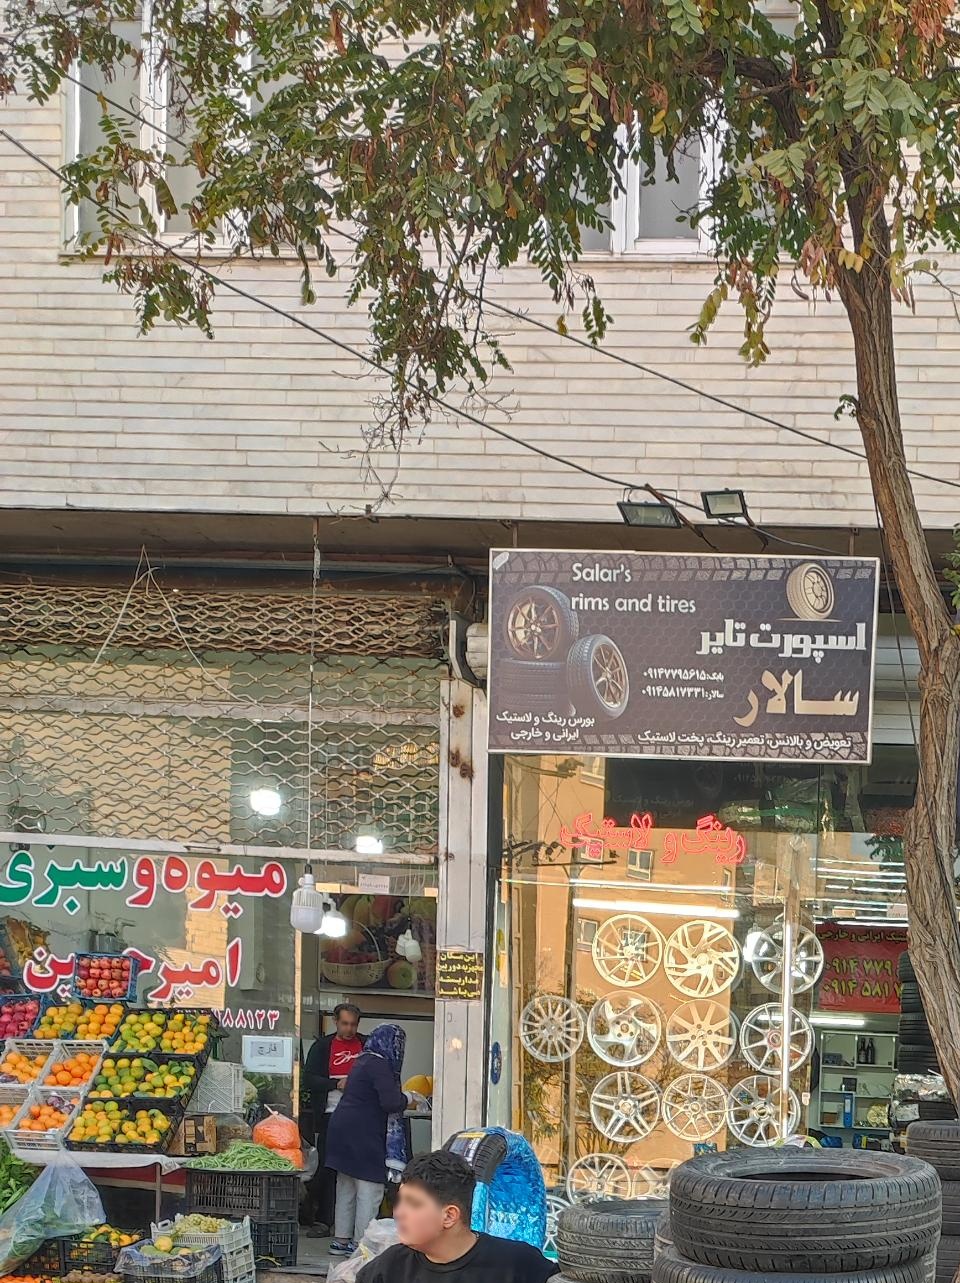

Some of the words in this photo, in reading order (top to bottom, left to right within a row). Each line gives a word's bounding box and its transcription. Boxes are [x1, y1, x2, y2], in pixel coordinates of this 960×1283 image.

[572, 562, 632, 583] Salar's
[571, 593, 610, 611] rims
[615, 593, 653, 612] and
[657, 595, 697, 613] tires
[695, 618, 747, 655] تایر
[750, 622, 867, 664] اسپورت
[732, 668, 860, 728] سالار
[496, 710, 532, 724] لاستیک
[533, 715, 541, 726] و
[542, 711, 567, 727] رینگ
[567, 716, 595, 728] بورس
[510, 726, 543, 741] خارجی
[544, 730, 551, 741] و
[552, 728, 579, 742] ایرانی
[637, 730, 676, 743] لاستیک
[678, 734, 704, 748] پخت
[737, 734, 765, 749] تعمیر
[805, 739, 812, 749] و
[813, 736, 852, 750] تعویض
[560, 812, 652, 858] لاستیک
[681, 814, 747, 864] رینگ
[660, 831, 678, 863] و
[0, 845, 128, 916] سبزی
[126, 856, 156, 908] و
[161, 854, 287, 919] میوه
